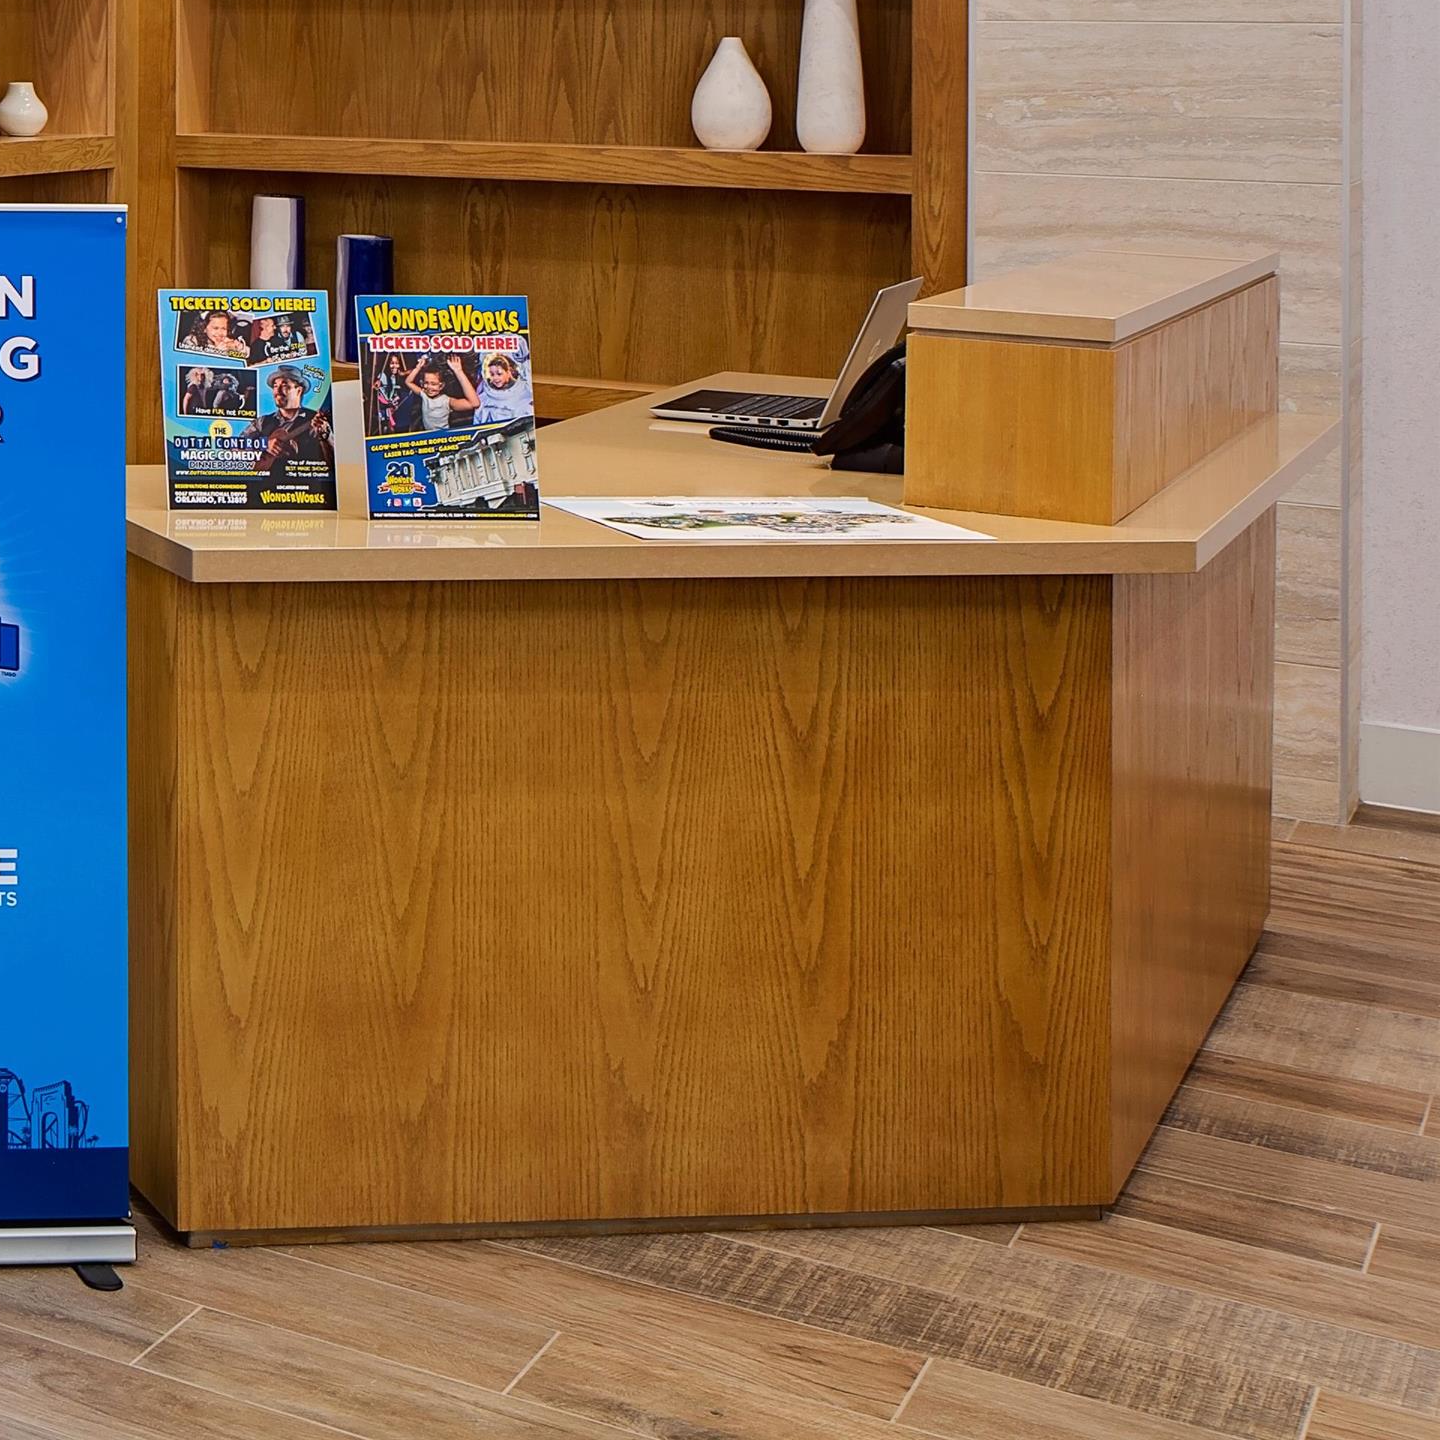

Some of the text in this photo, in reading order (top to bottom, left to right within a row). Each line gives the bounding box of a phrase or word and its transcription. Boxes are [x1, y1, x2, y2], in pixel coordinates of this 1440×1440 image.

[170, 297, 316, 311] TICKETS SOLD HERE!
[370, 337, 518, 350] TICKETS SOLD HERE!
[174, 437, 267, 448] OUTTA CONTROL
[181, 450, 262, 460] MAGIC COMEDY
[188, 461, 255, 470] DINNER SHOW
[175, 496, 216, 504] ORLANDO,
[218, 496, 226, 504] FL
